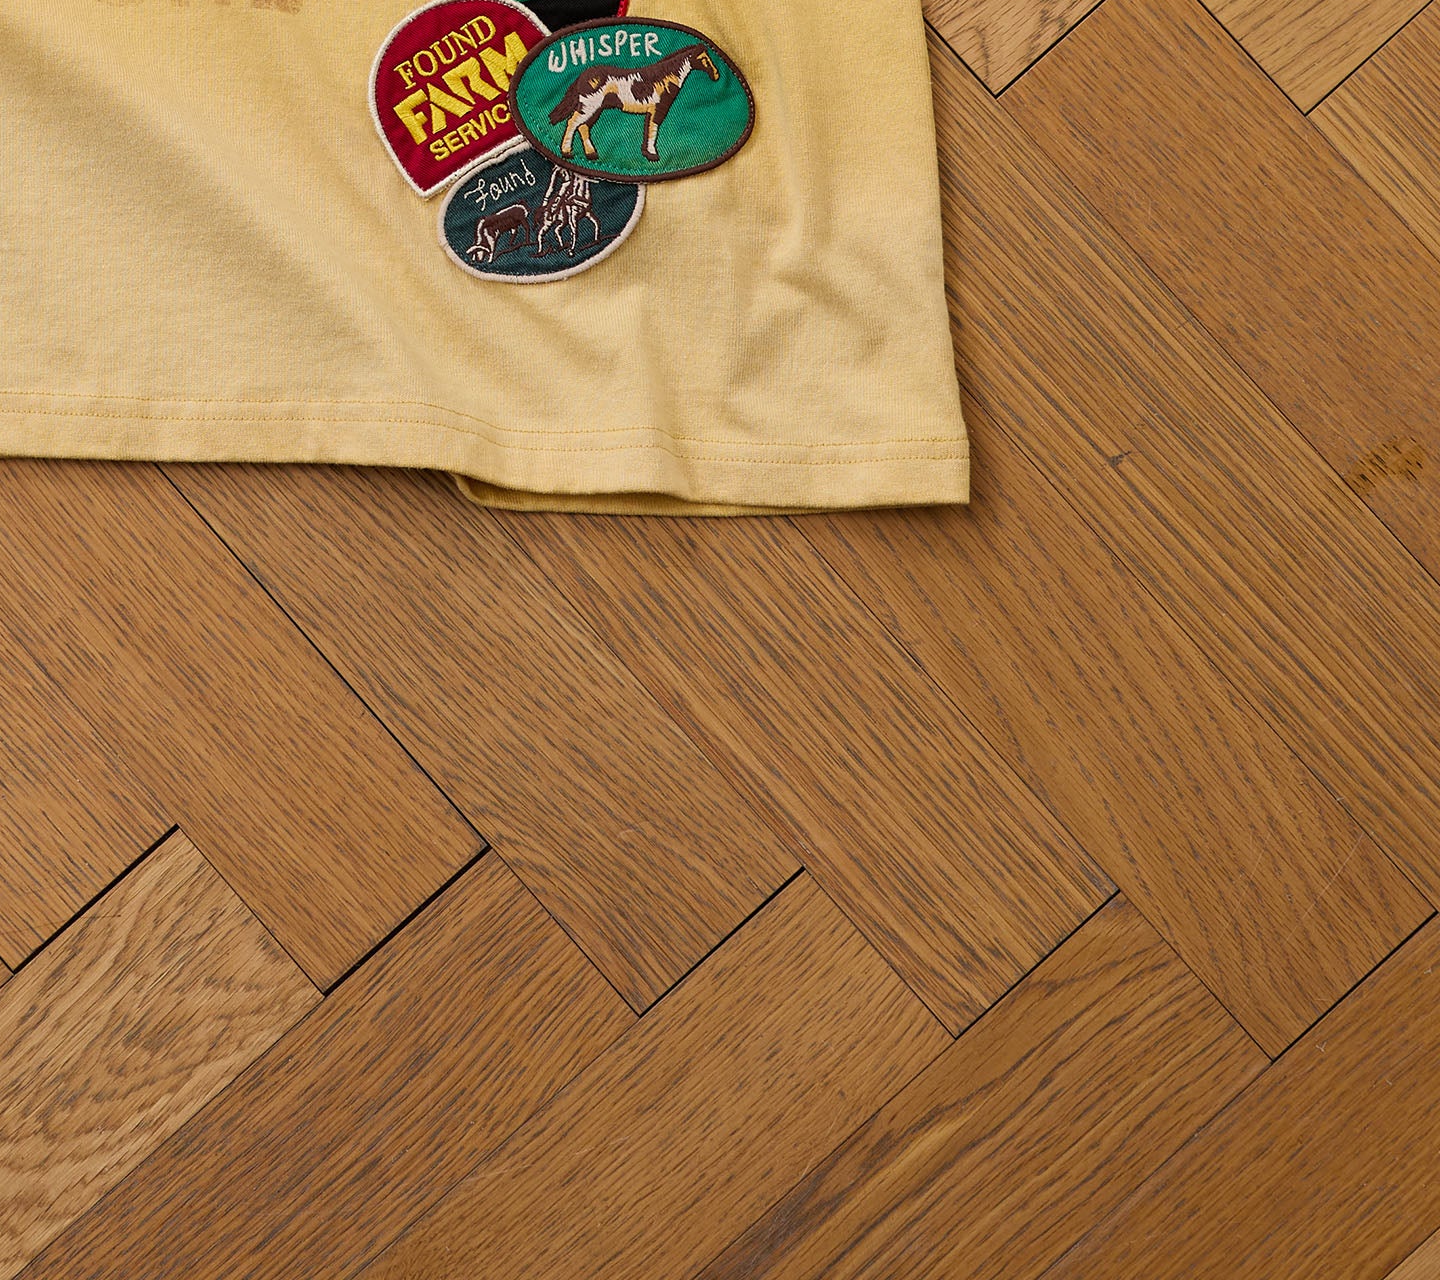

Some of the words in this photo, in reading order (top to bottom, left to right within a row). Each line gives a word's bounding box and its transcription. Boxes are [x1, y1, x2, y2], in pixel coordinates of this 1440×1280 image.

[393, 15, 497, 90] FOUND
[548, 29, 662, 73] WHISPER
[393, 31, 529, 146] FARM
[429, 100, 511, 162] SERVIC
